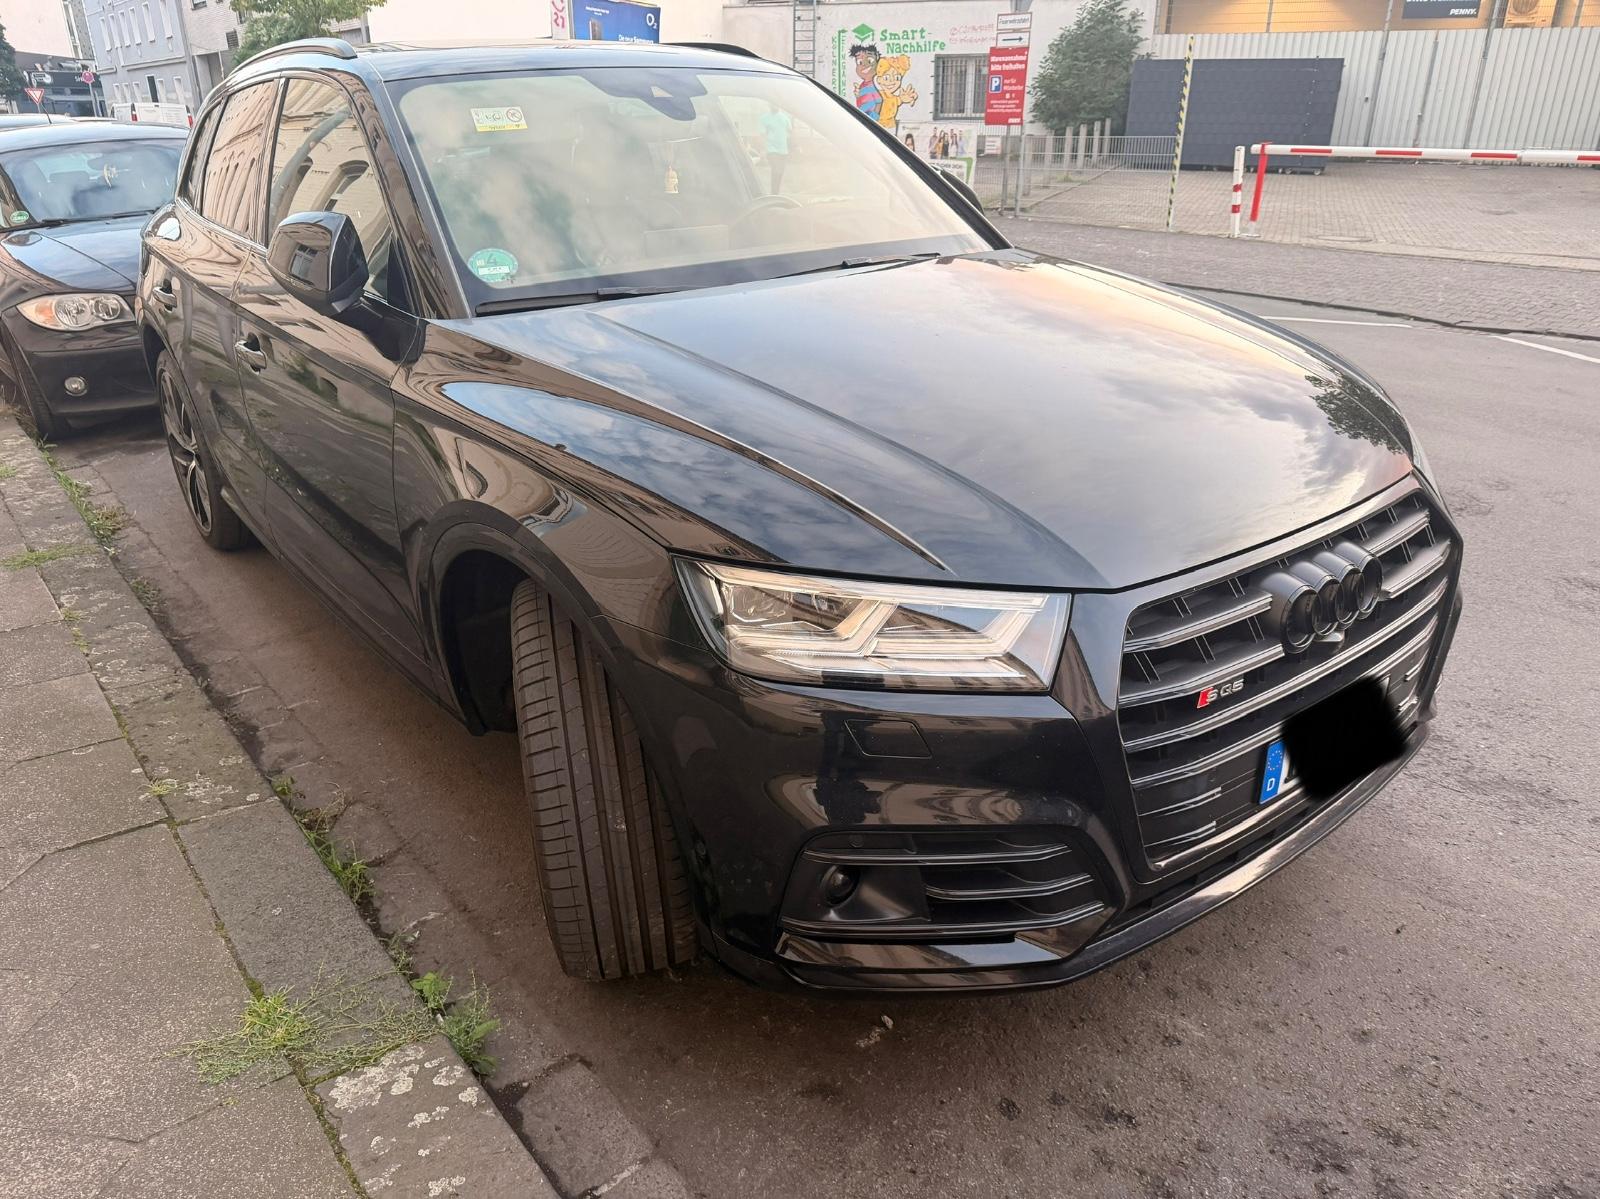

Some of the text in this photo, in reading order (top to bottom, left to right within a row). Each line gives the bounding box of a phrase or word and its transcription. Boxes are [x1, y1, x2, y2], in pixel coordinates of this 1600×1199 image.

[880, 27, 933, 42] Smart-
[886, 40, 946, 54] Nachhilfe
[991, 77, 1000, 91] P
[1205, 678, 1245, 703] SQ5
[1266, 777, 1275, 792] D
